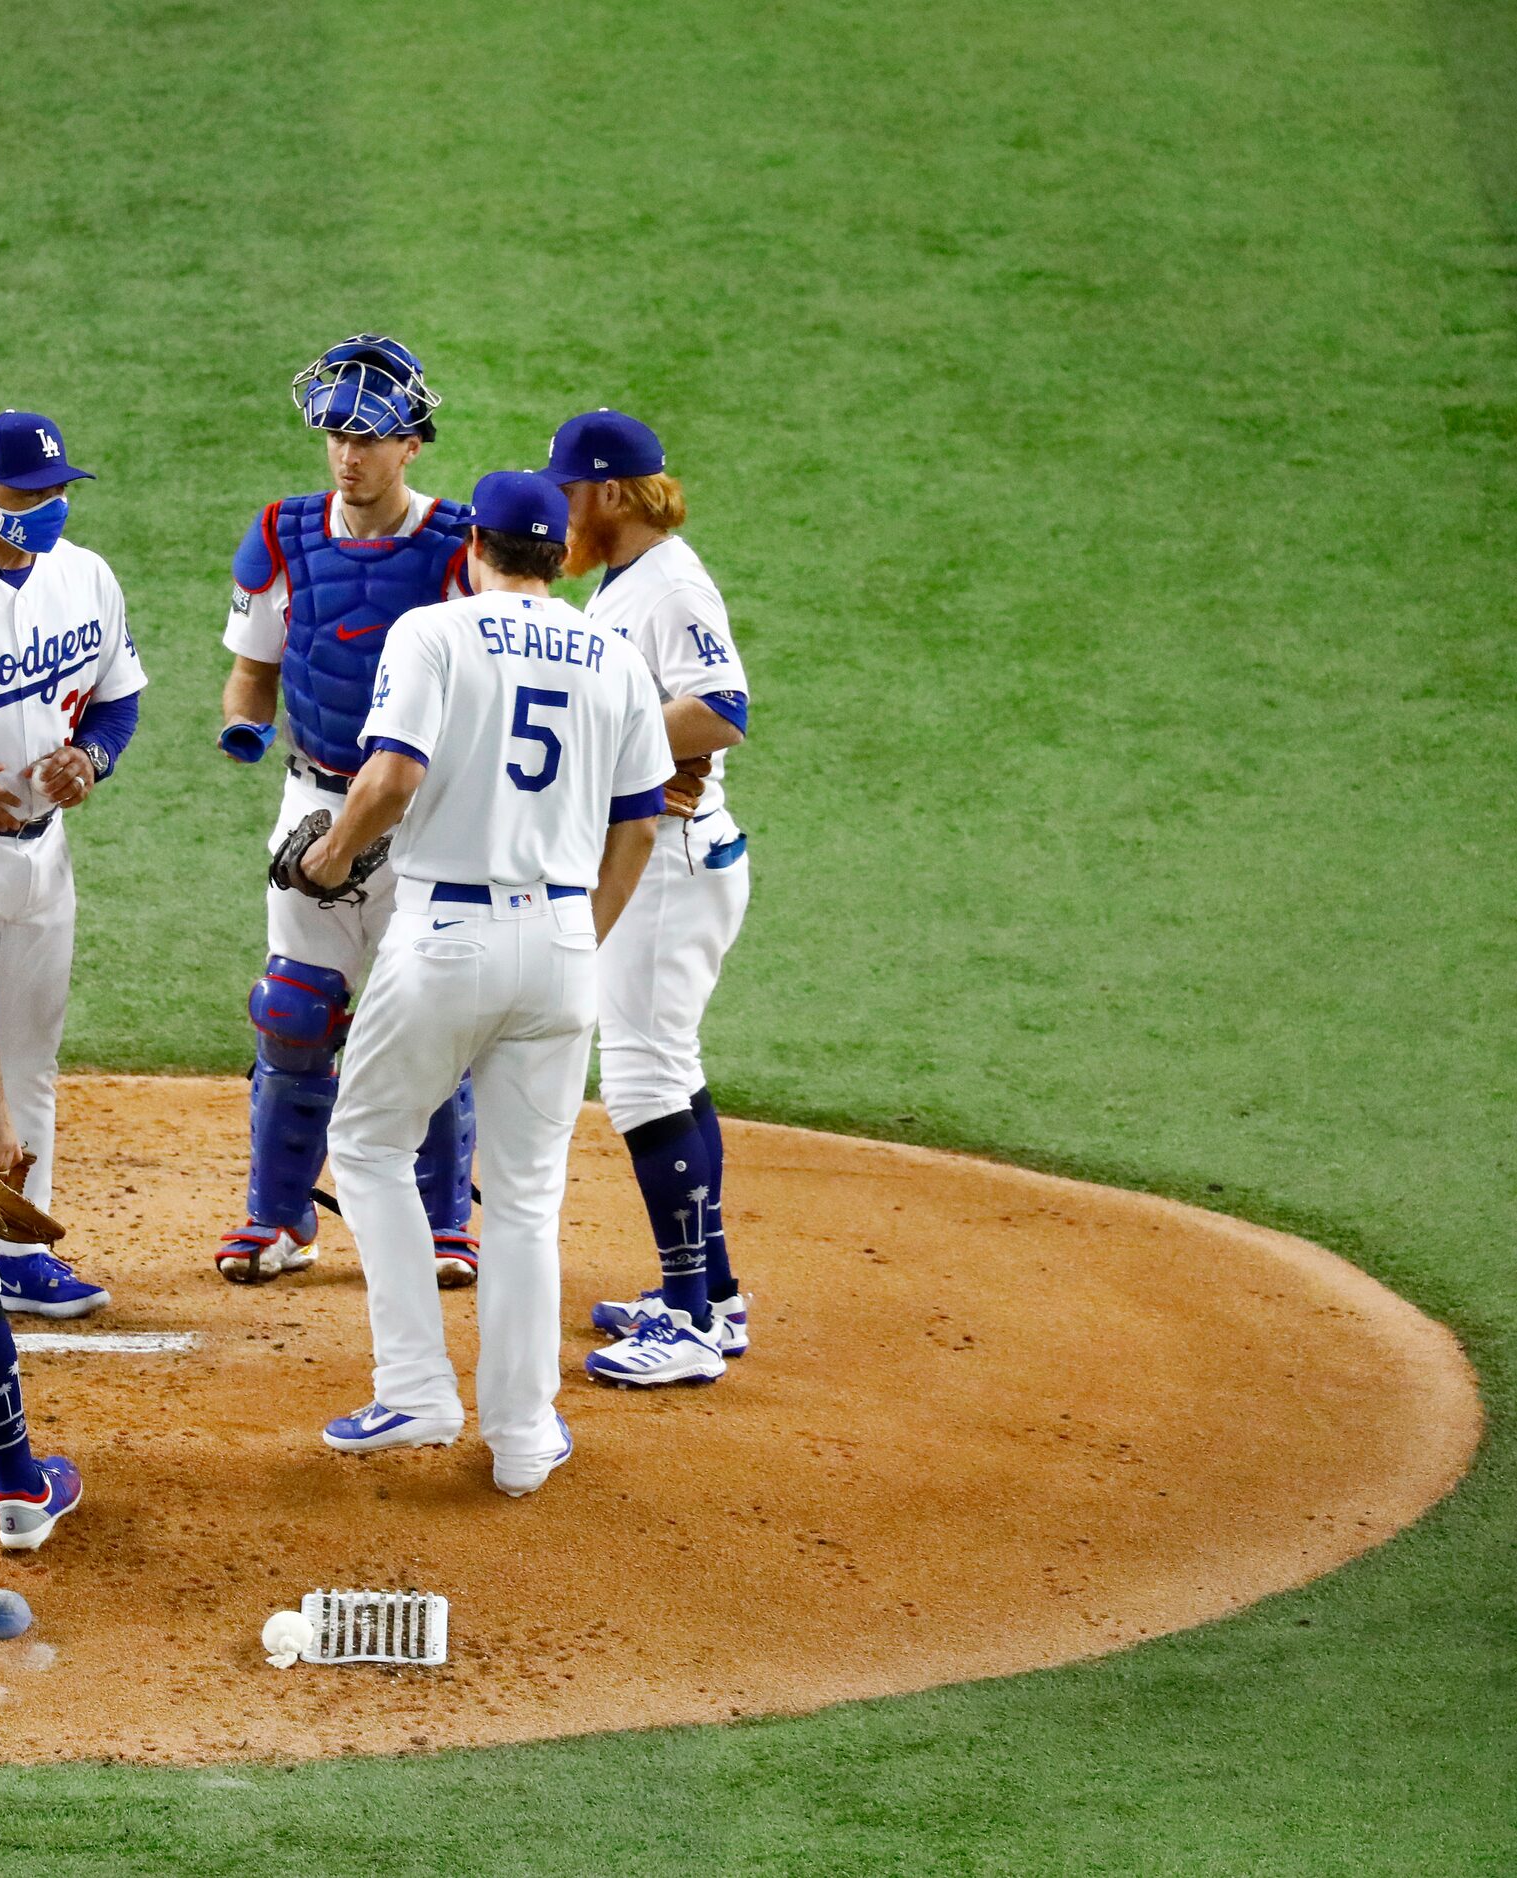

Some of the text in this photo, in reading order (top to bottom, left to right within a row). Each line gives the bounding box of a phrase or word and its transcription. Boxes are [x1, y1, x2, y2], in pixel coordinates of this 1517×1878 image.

[35, 429, 61, 458] LA
[7, 517, 28, 544] LA
[478, 617, 605, 674] SEAGER
[687, 623, 730, 667] LA
[506, 685, 569, 793] 5
[5, 1517, 16, 1532] 3
